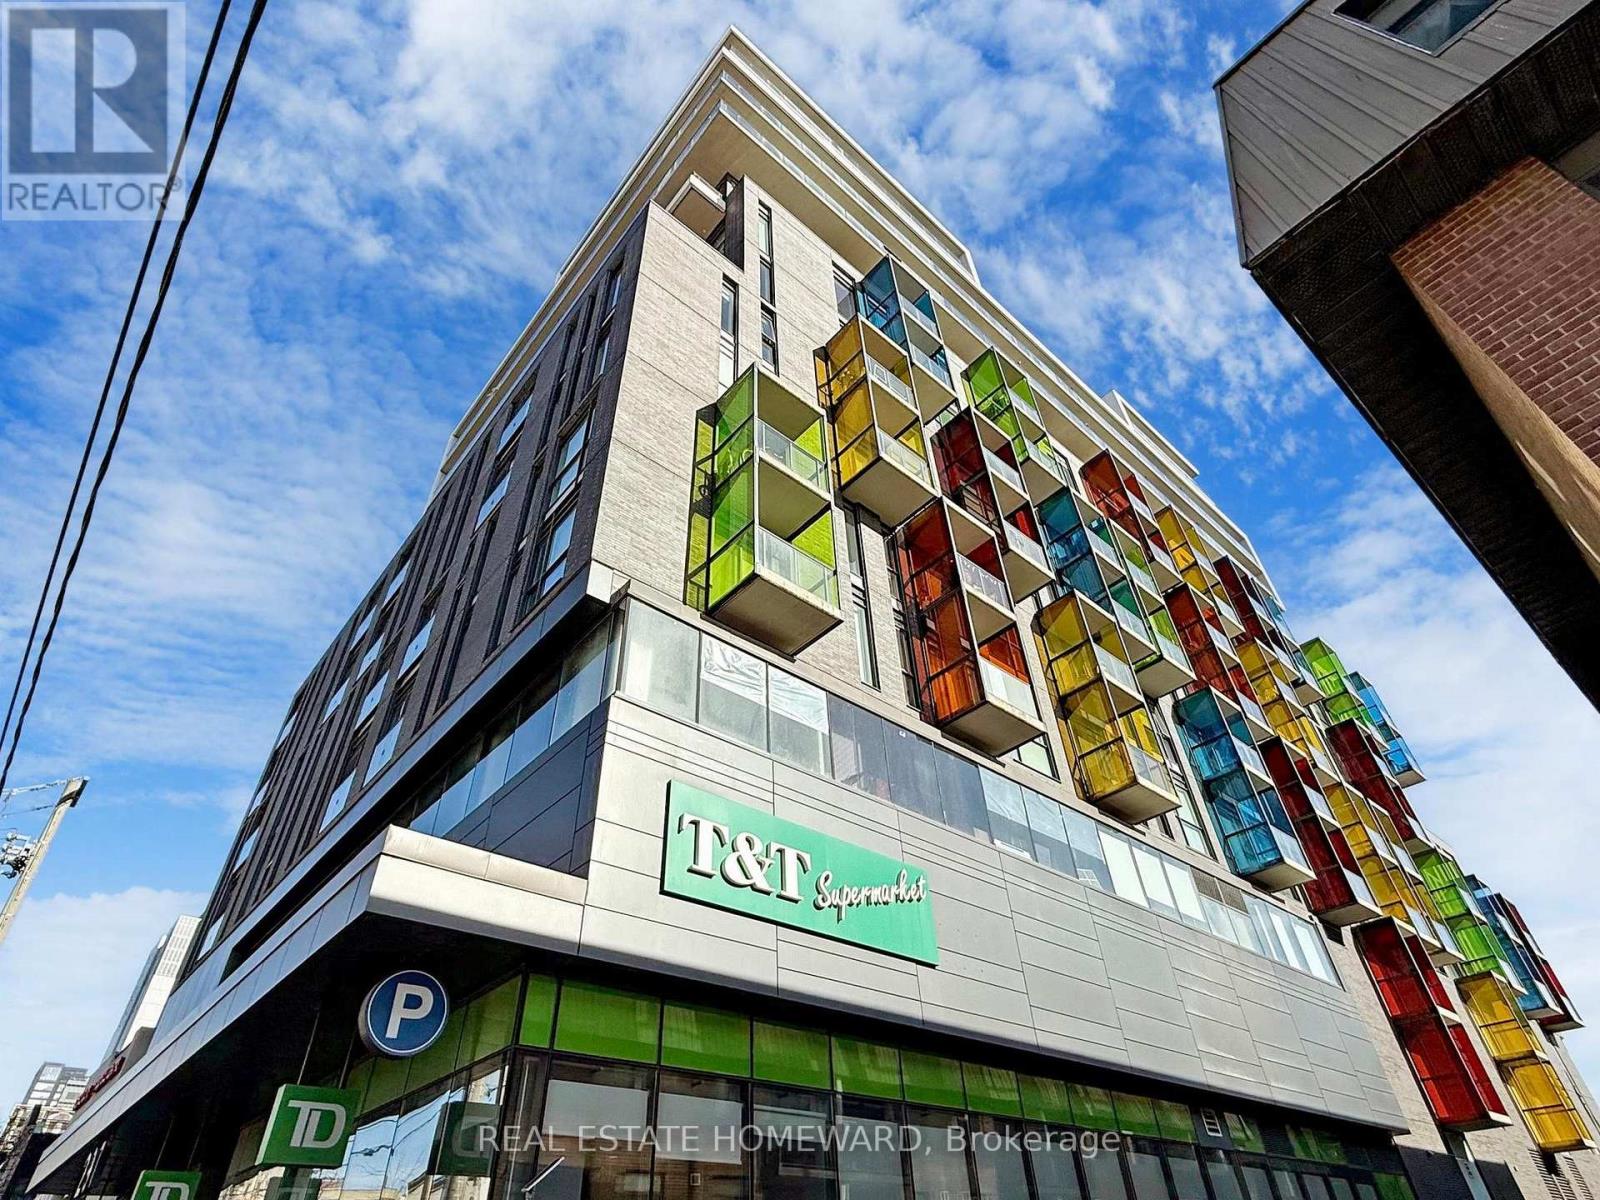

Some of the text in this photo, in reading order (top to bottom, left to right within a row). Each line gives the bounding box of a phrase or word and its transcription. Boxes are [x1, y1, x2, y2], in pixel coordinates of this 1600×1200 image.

[677, 813, 927, 924] T&T Supermarket
[385, 982, 434, 1039] P
[287, 1099, 347, 1149] TD
